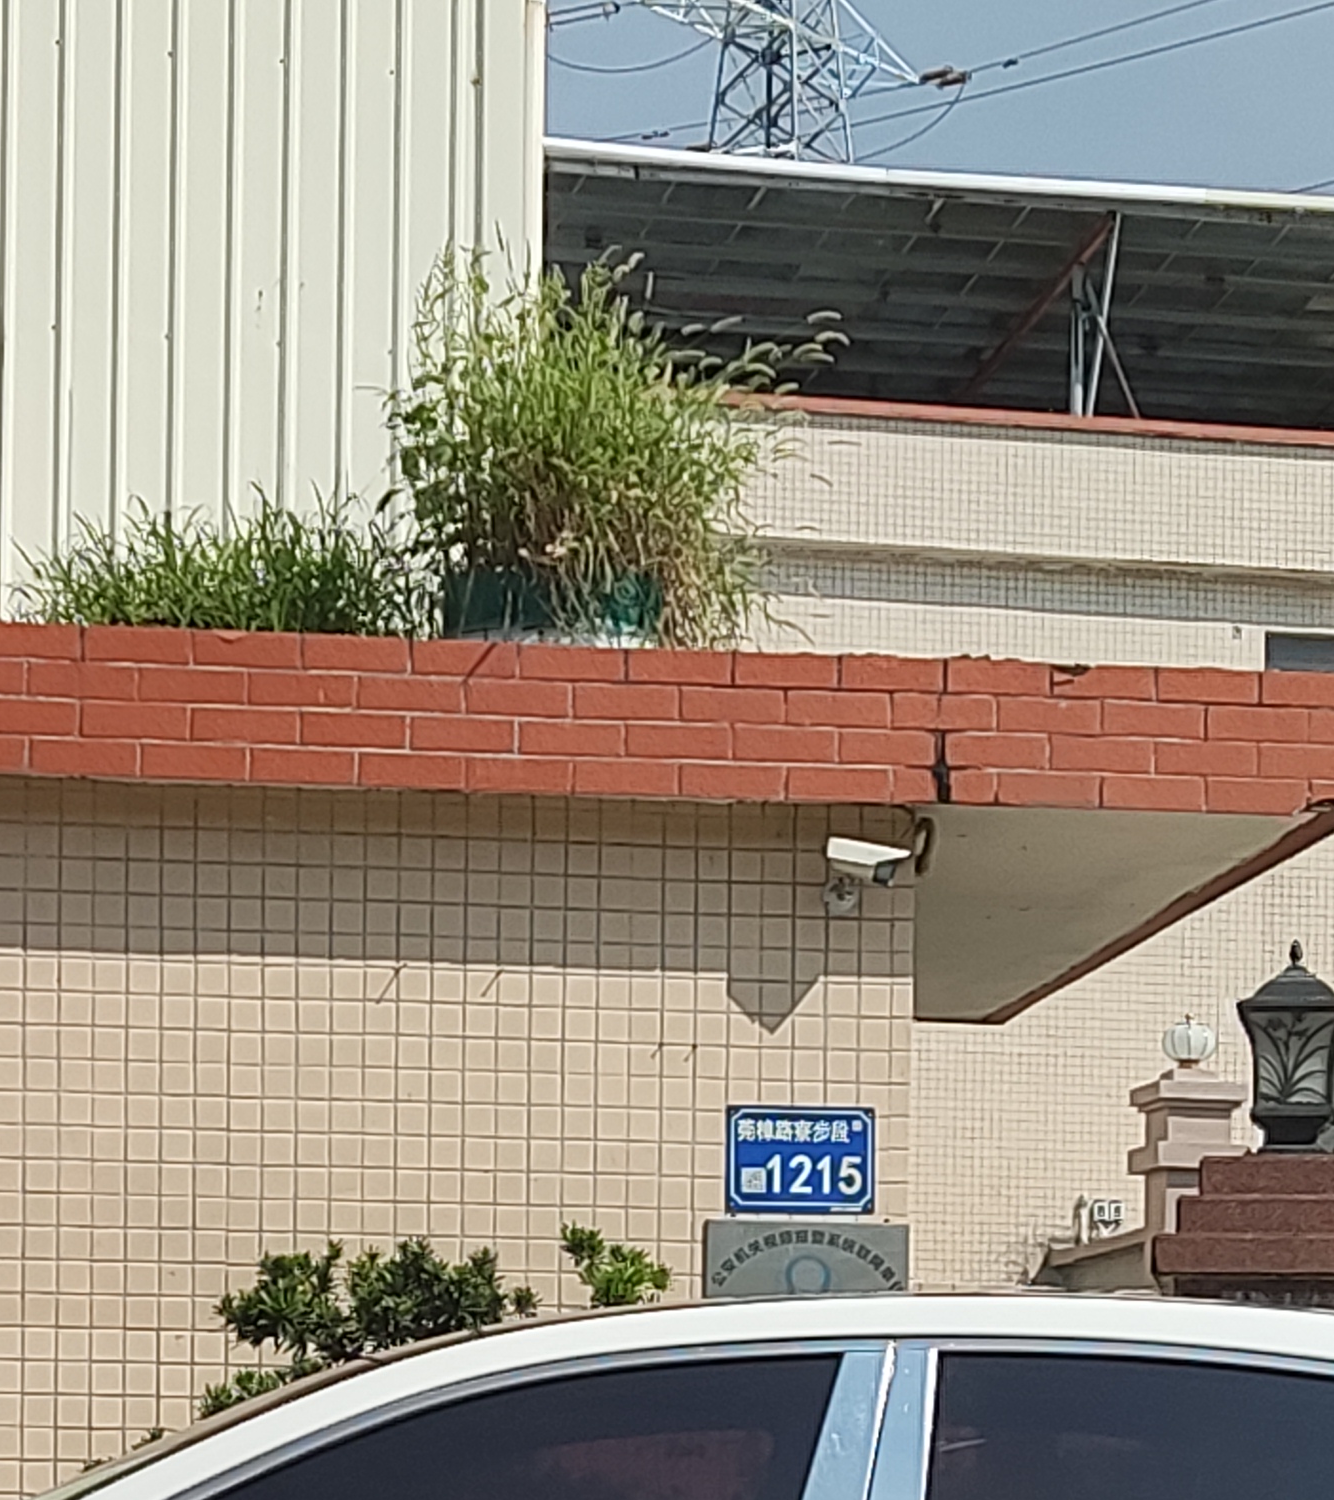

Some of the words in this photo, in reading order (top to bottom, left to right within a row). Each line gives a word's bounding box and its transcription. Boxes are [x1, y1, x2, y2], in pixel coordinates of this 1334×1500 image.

[737, 1118, 851, 1144] 莞樟路寮步段
[767, 1154, 863, 1196] 1215
